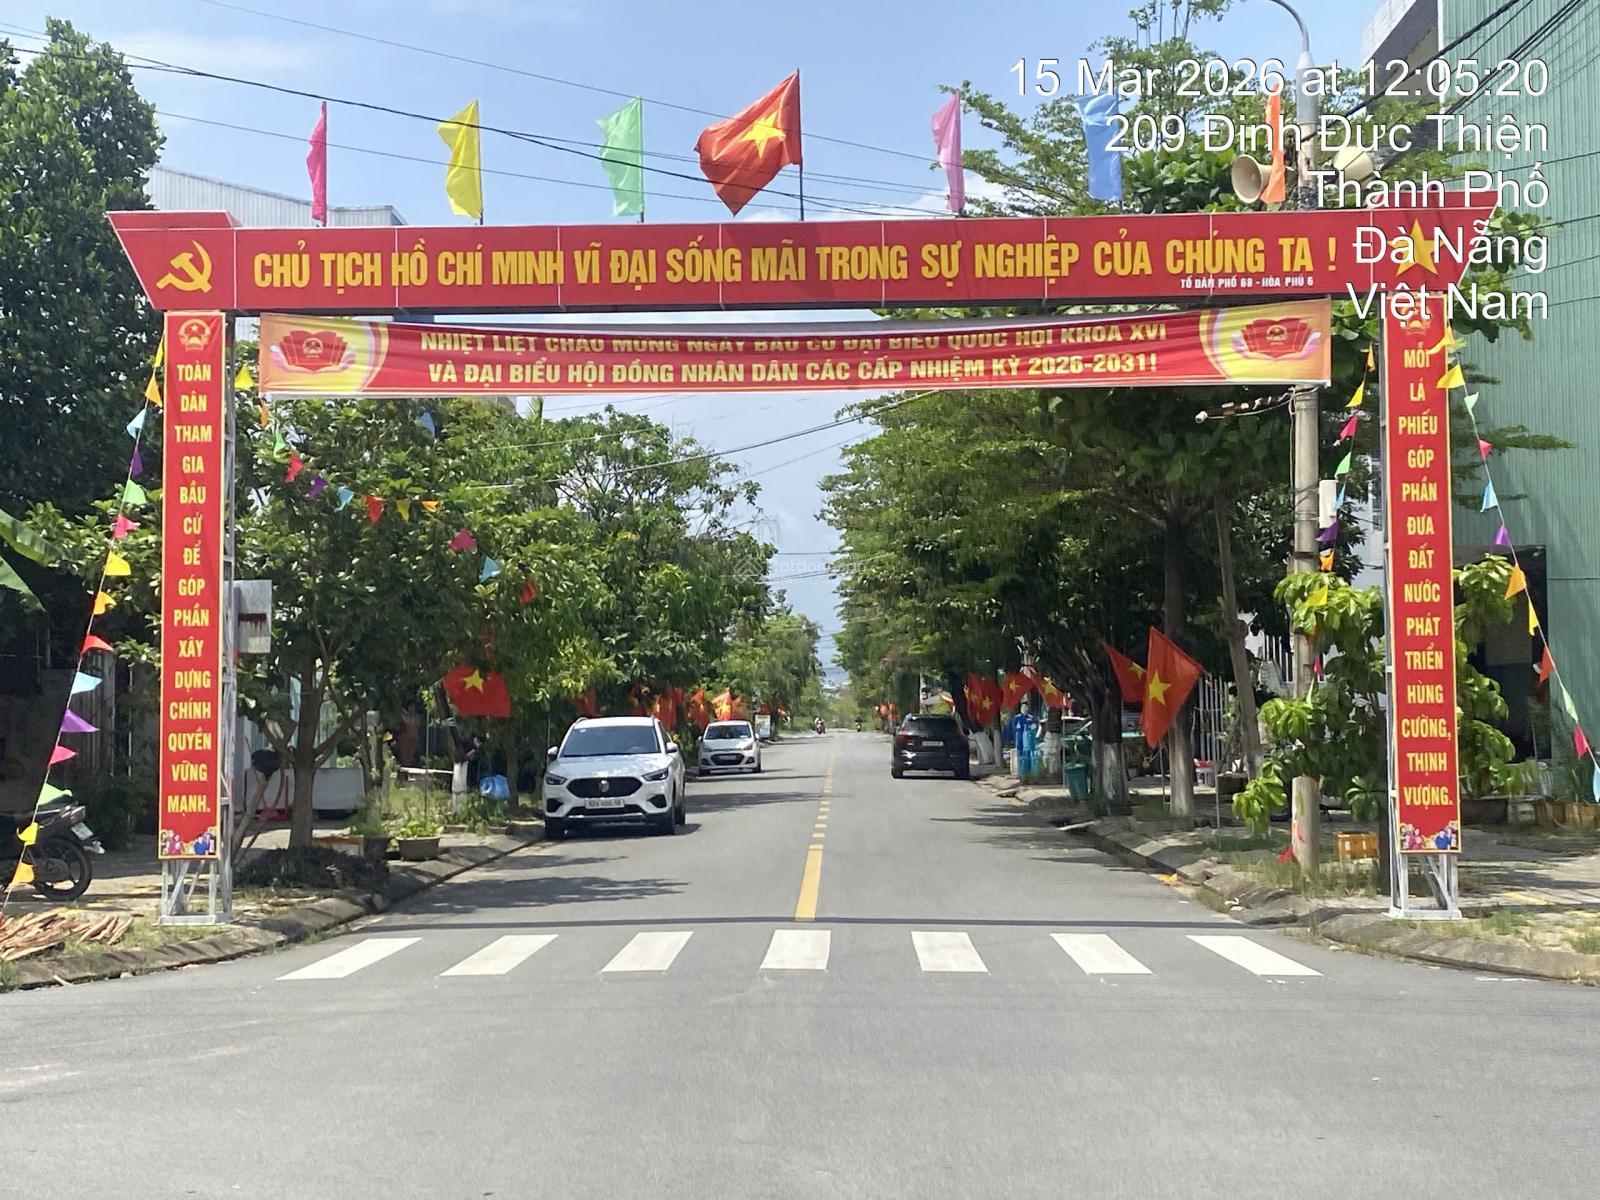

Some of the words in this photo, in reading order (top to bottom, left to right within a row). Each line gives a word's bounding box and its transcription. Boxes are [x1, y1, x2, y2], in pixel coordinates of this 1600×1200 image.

[254, 240, 311, 288] CHỦ
[319, 252, 382, 295] TỊCH
[391, 238, 428, 286] HỒ
[438, 244, 483, 286] CHÍ
[492, 250, 564, 286] MINH
[574, 242, 602, 284] VĨ
[610, 248, 656, 291] ĐẠI
[666, 235, 742, 283] SỐNG
[751, 239, 805, 282] MÃI
[815, 244, 908, 281] TRONG
[922, 240, 962, 287] SỰ
[974, 235, 1080, 285] NGHIỆP
[1094, 228, 1152, 277] CỦA
[1166, 230, 1265, 275] CHÚNG
[1278, 237, 1313, 272] TA
[1218, 275, 1237, 288] PHỐ
[1307, 276, 1313, 286] 6
[1130, 323, 1167, 341] XVI
[177, 360, 211, 382] TOÀN
[428, 360, 457, 383] VÀ
[464, 364, 502, 387] ĐẠI
[509, 357, 560, 383] BIỂU
[568, 361, 605, 387] HỘI
[612, 359, 674, 383] ĐỒNG
[681, 360, 744, 382] NHÂN
[752, 360, 798, 382] DÂN
[805, 359, 850, 380] CÁC
[858, 355, 902, 379] CẤP
[910, 356, 984, 381] NHIỆM
[992, 354, 1021, 376] KỲ
[1028, 353, 1157, 375] 2026-2031!
[180, 390, 207, 412] DÂN
[1410, 378, 1426, 402] LÁ
[175, 425, 212, 443] THAM
[1399, 409, 1438, 435] PHIẾU
[182, 456, 204, 473] GIA
[1408, 445, 1434, 469] GÓP
[183, 511, 203, 535] CỬ
[1407, 514, 1435, 536] ĐƯA
[183, 539, 201, 565] ĐỂ
[1409, 543, 1434, 569] ĐẤT
[178, 574, 205, 596] GÓP
[1404, 578, 1440, 603] NƯỚC
[1406, 612, 1440, 637] PHÁT
[179, 636, 204, 657] XÂY
[1405, 642, 1443, 670] TRIỂN
[175, 669, 211, 693] DỰNG
[1407, 680, 1443, 704] HÙNG
[169, 697, 211, 720] CHÍNH
[168, 726, 212, 751] QUYỀN
[172, 760, 207, 782] VỮNG
[1407, 752, 1447, 776] THỊNH
[167, 795, 211, 817] MẠNH.
[1404, 784, 1453, 810] VƯỢNG.
